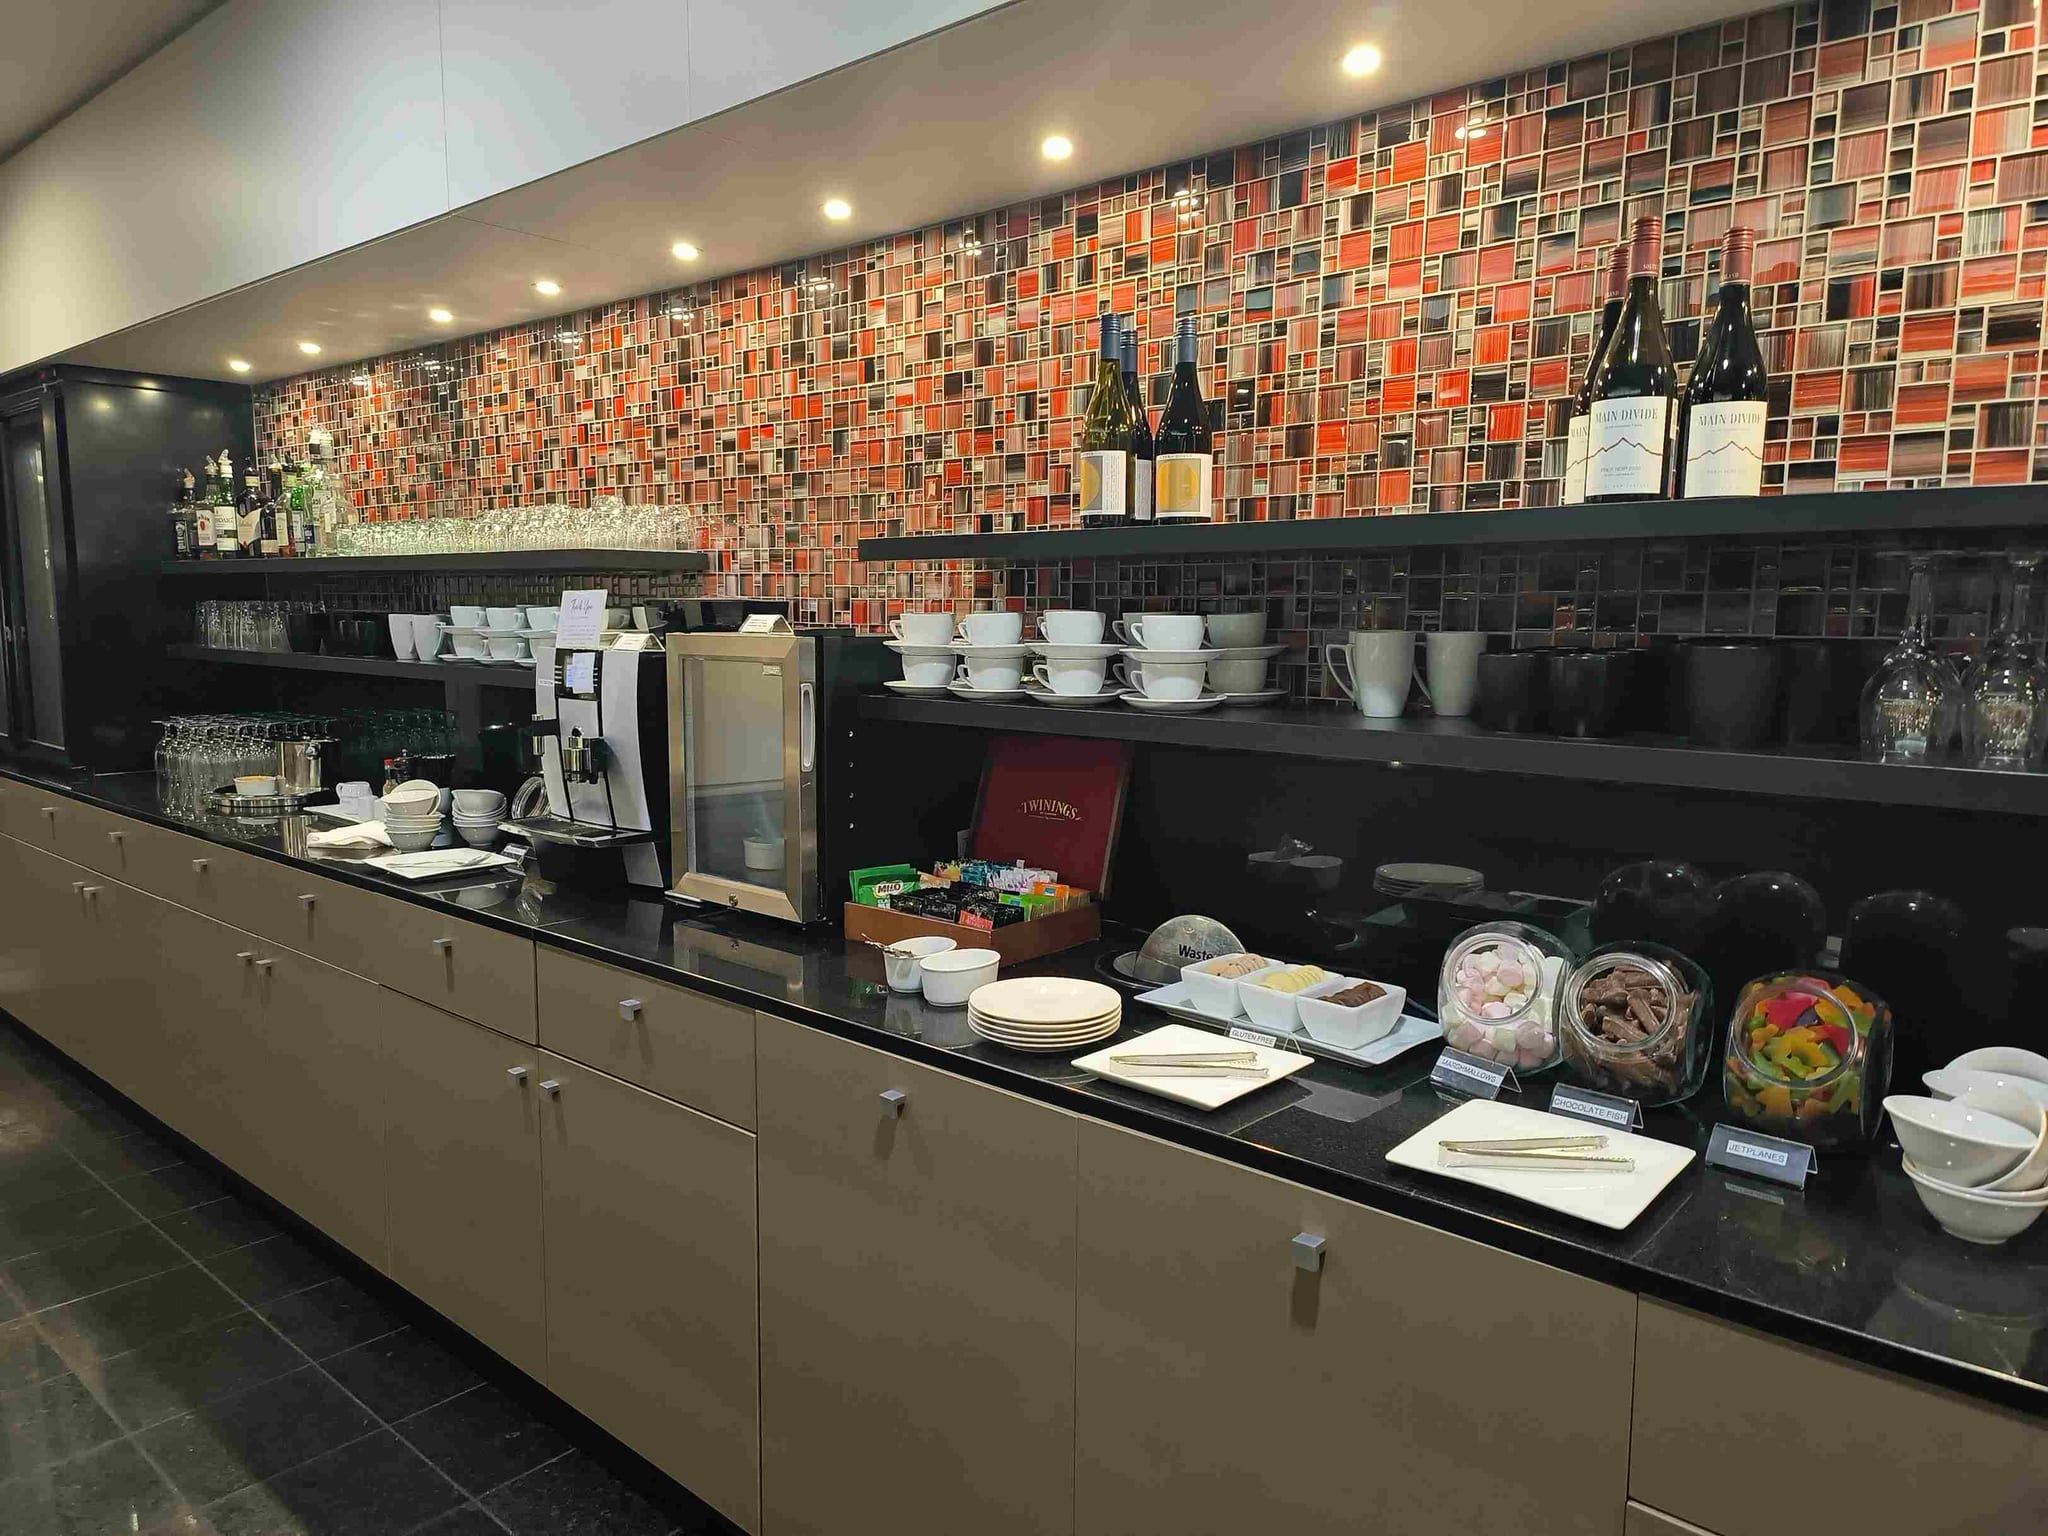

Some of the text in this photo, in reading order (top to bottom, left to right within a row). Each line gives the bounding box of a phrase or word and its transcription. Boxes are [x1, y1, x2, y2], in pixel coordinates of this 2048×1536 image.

[1595, 407, 1659, 424] MAIN DIVIDE
[1698, 413, 1727, 426] MAIN
[1021, 798, 1078, 820] TWININGS
[877, 882, 901, 894] MILO
[1178, 943, 1215, 961] Waste
[1231, 1029, 1275, 1045] GLUTEN FREE
[1441, 1057, 1497, 1084] MARSHMALLOWS
[1553, 1096, 1628, 1122] CHOCOLATE FISH
[1728, 1140, 1786, 1164] JETPLANES
